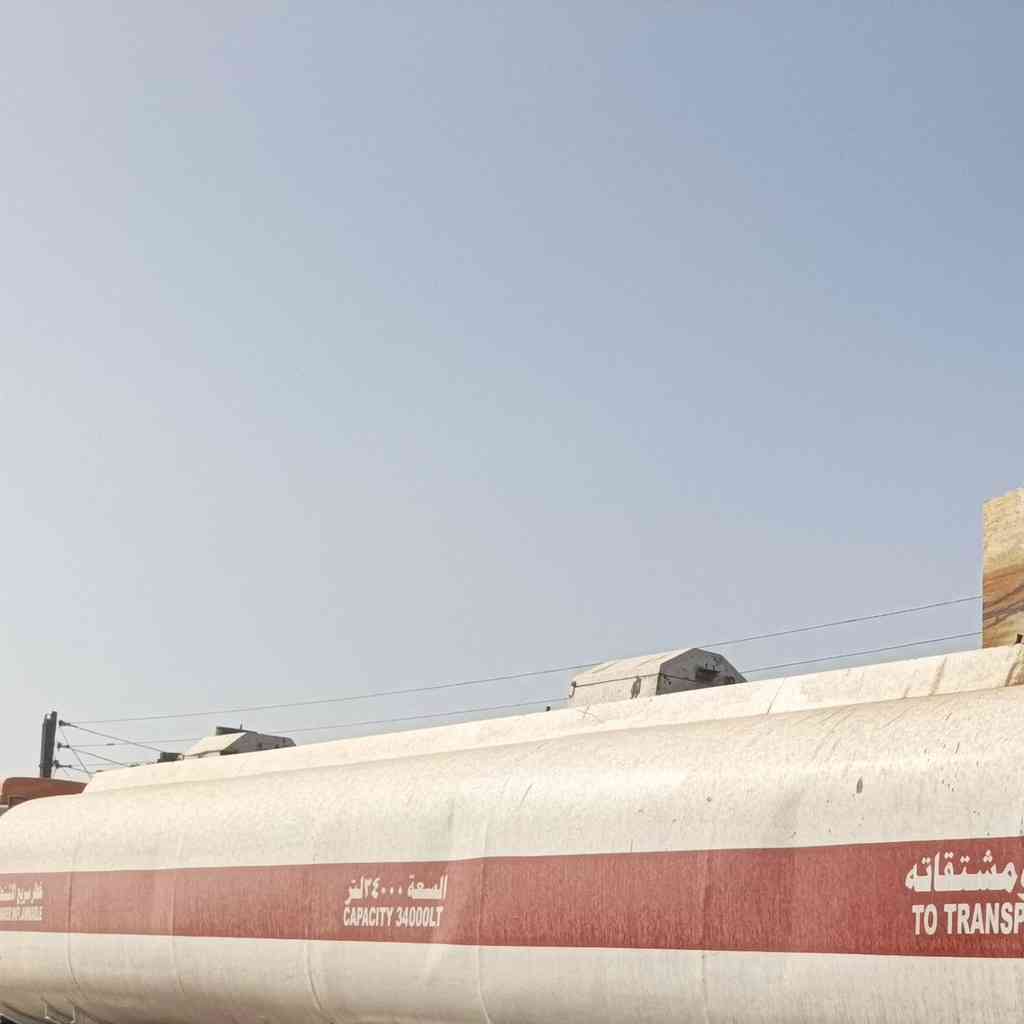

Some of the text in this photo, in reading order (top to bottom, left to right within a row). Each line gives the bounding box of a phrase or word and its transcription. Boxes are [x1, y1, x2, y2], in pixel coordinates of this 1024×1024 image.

[407, 874, 449, 900] السعة
[343, 906, 444, 928] CAPACITY 34000LT
[912, 903, 938, 935] TO
